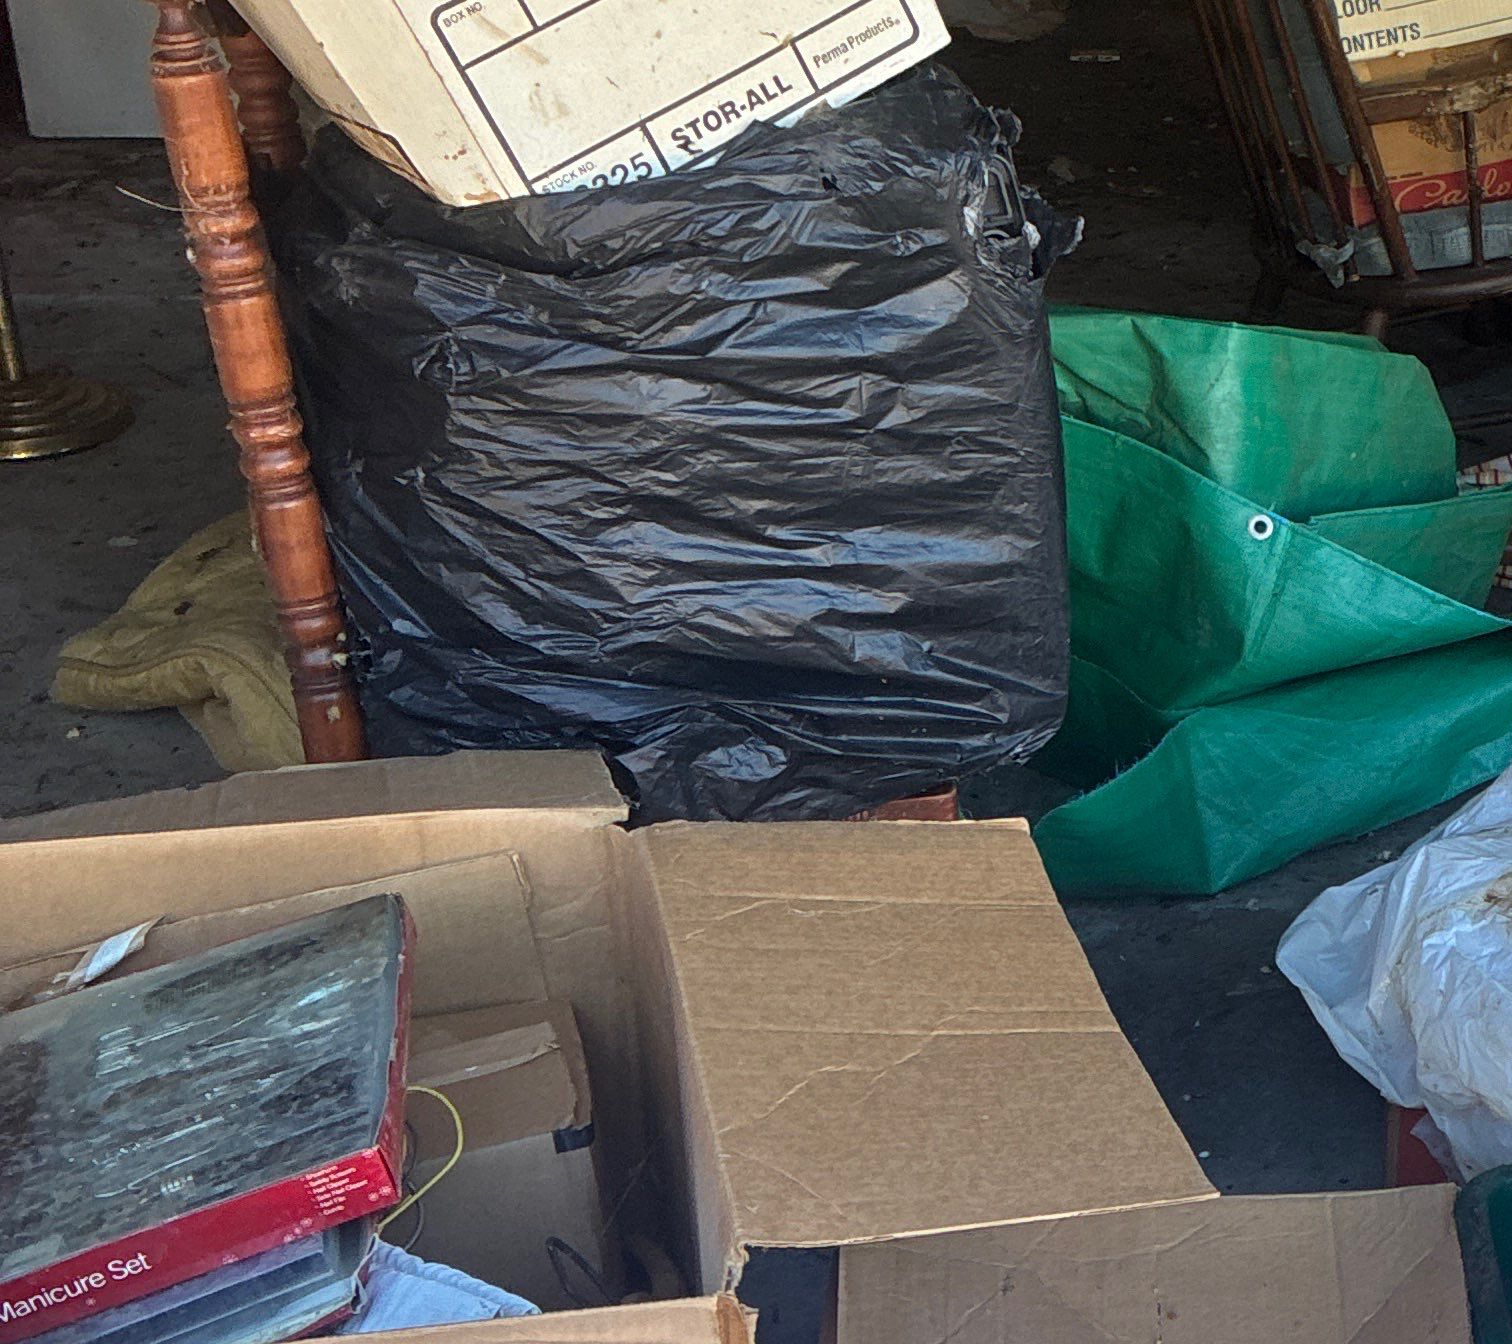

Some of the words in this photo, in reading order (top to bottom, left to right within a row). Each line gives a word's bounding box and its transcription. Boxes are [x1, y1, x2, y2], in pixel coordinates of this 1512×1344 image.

[442, 10, 466, 29] BOX
[466, 1, 485, 17] NO.
[813, 43, 849, 68] Perma
[1341, 22, 1421, 56] ONTENTS
[670, 74, 794, 145] STOR-ALL
[542, 167, 579, 195] STOCK
[578, 161, 598, 175] NO.
[0, 1272, 107, 1324] Manicure
[107, 1252, 152, 1280] Set
